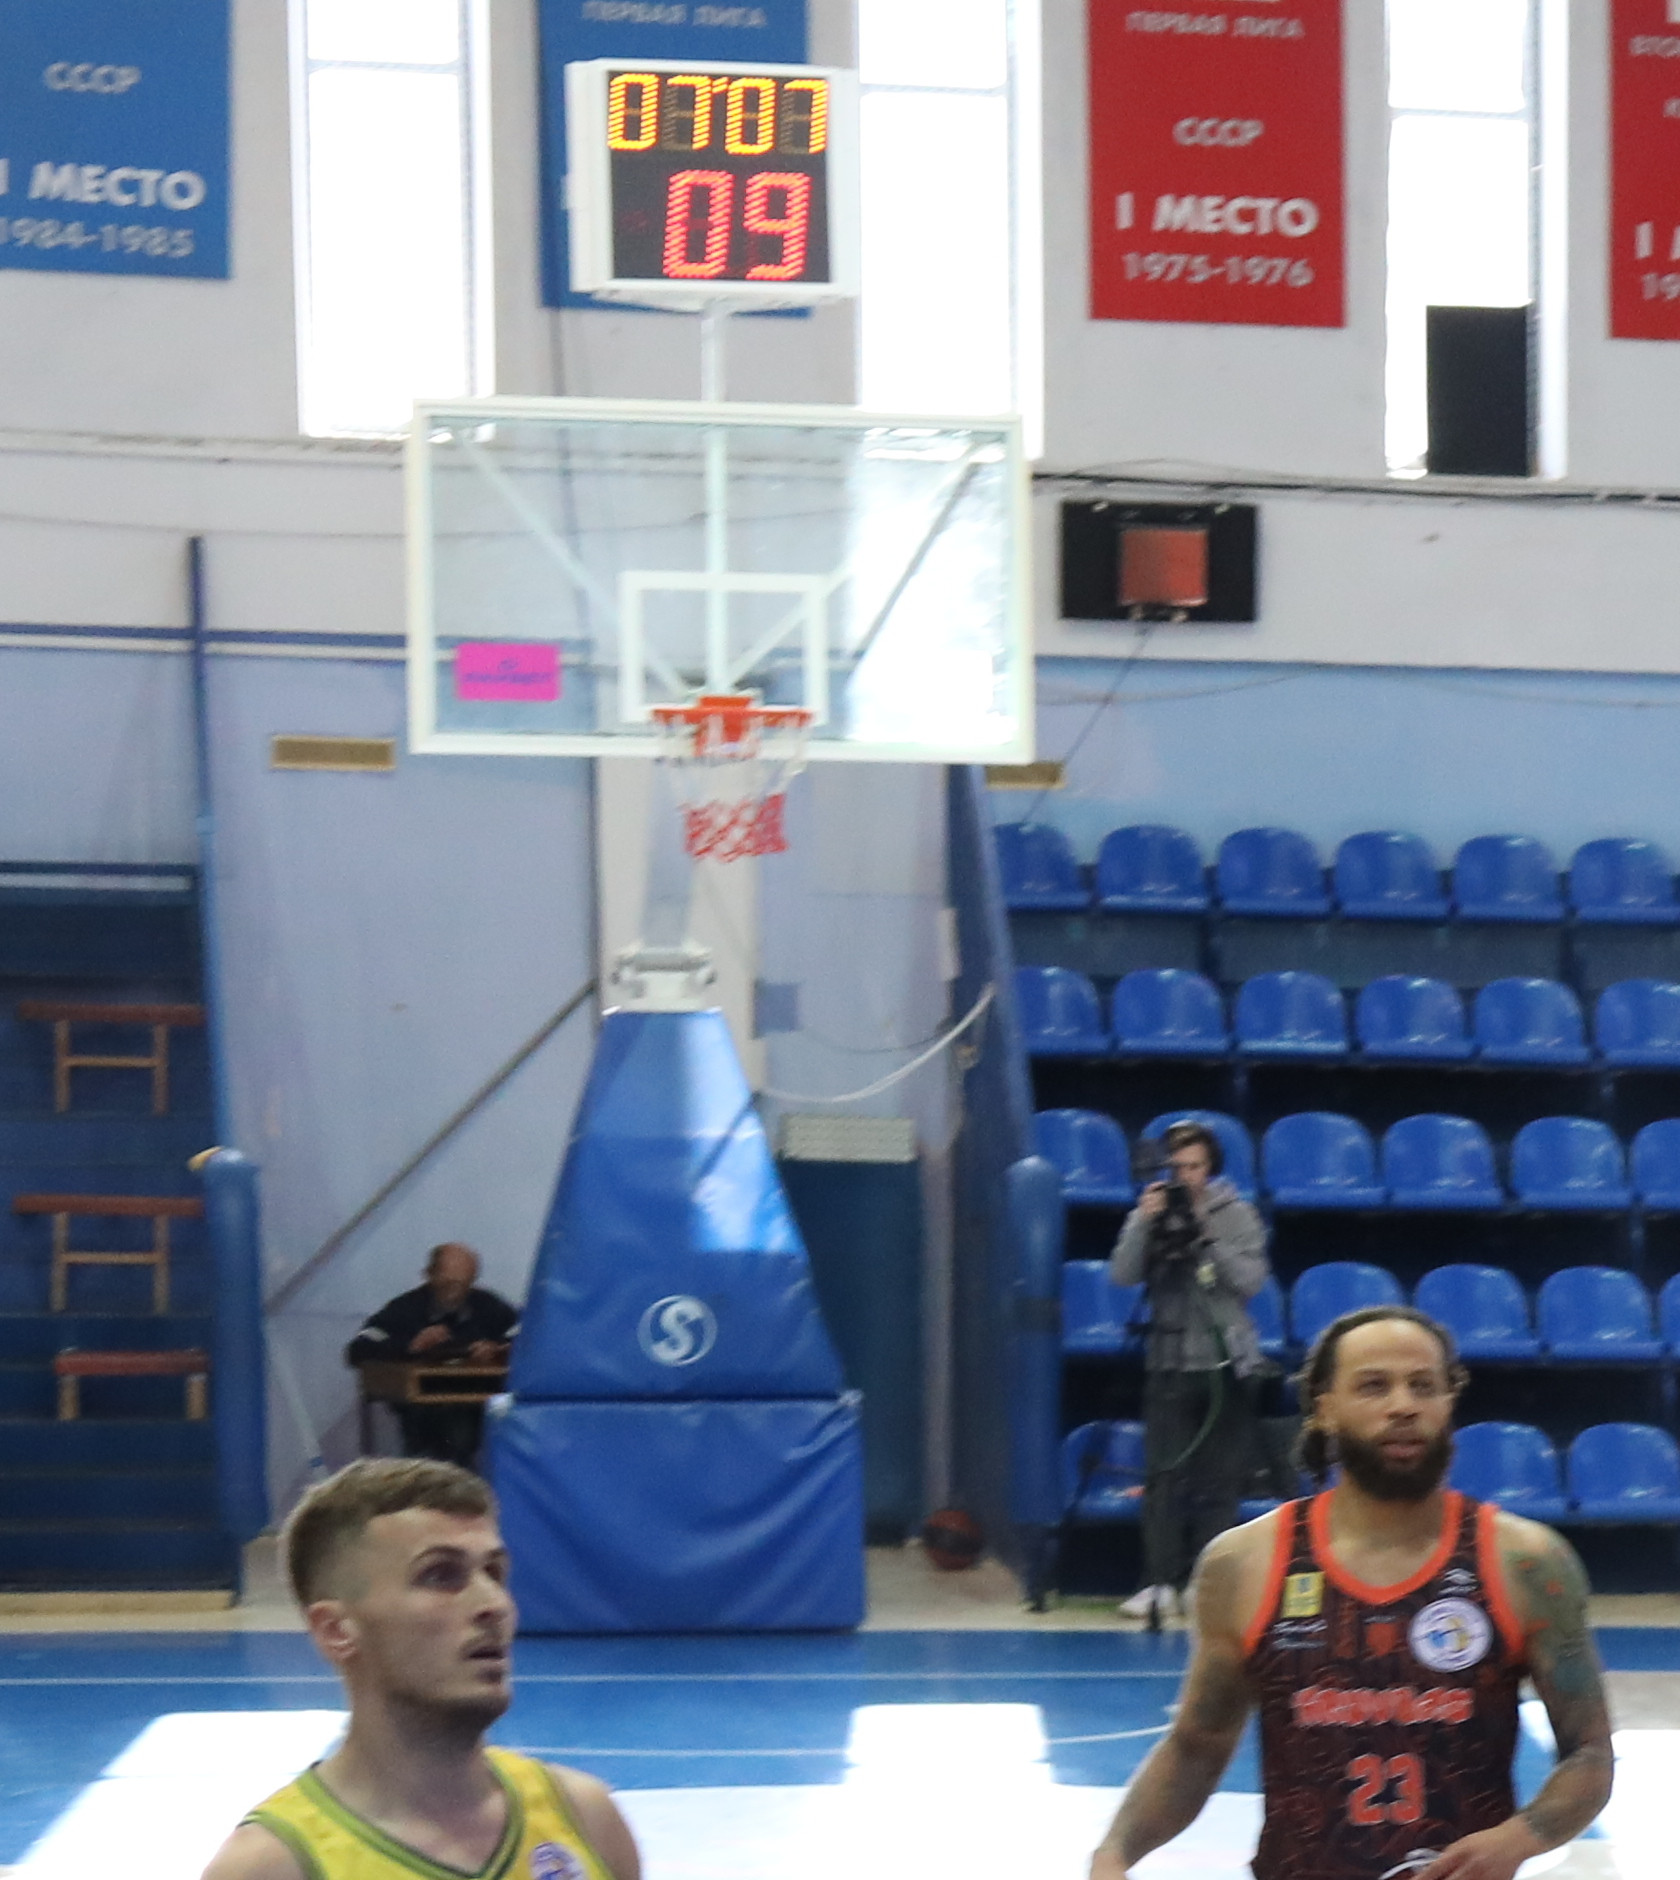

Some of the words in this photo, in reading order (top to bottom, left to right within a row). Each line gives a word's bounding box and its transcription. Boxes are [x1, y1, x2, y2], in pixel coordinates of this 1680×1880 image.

[45, 61, 142, 94] СССР
[1172, 117, 1265, 147] СССР
[28, 161, 208, 211] МЕСТО
[662, 169, 813, 280] 09
[1153, 194, 1320, 238] МЕСТО
[1122, 252, 1316, 287] 1975-1976
[1347, 1754, 1426, 1826] 23
